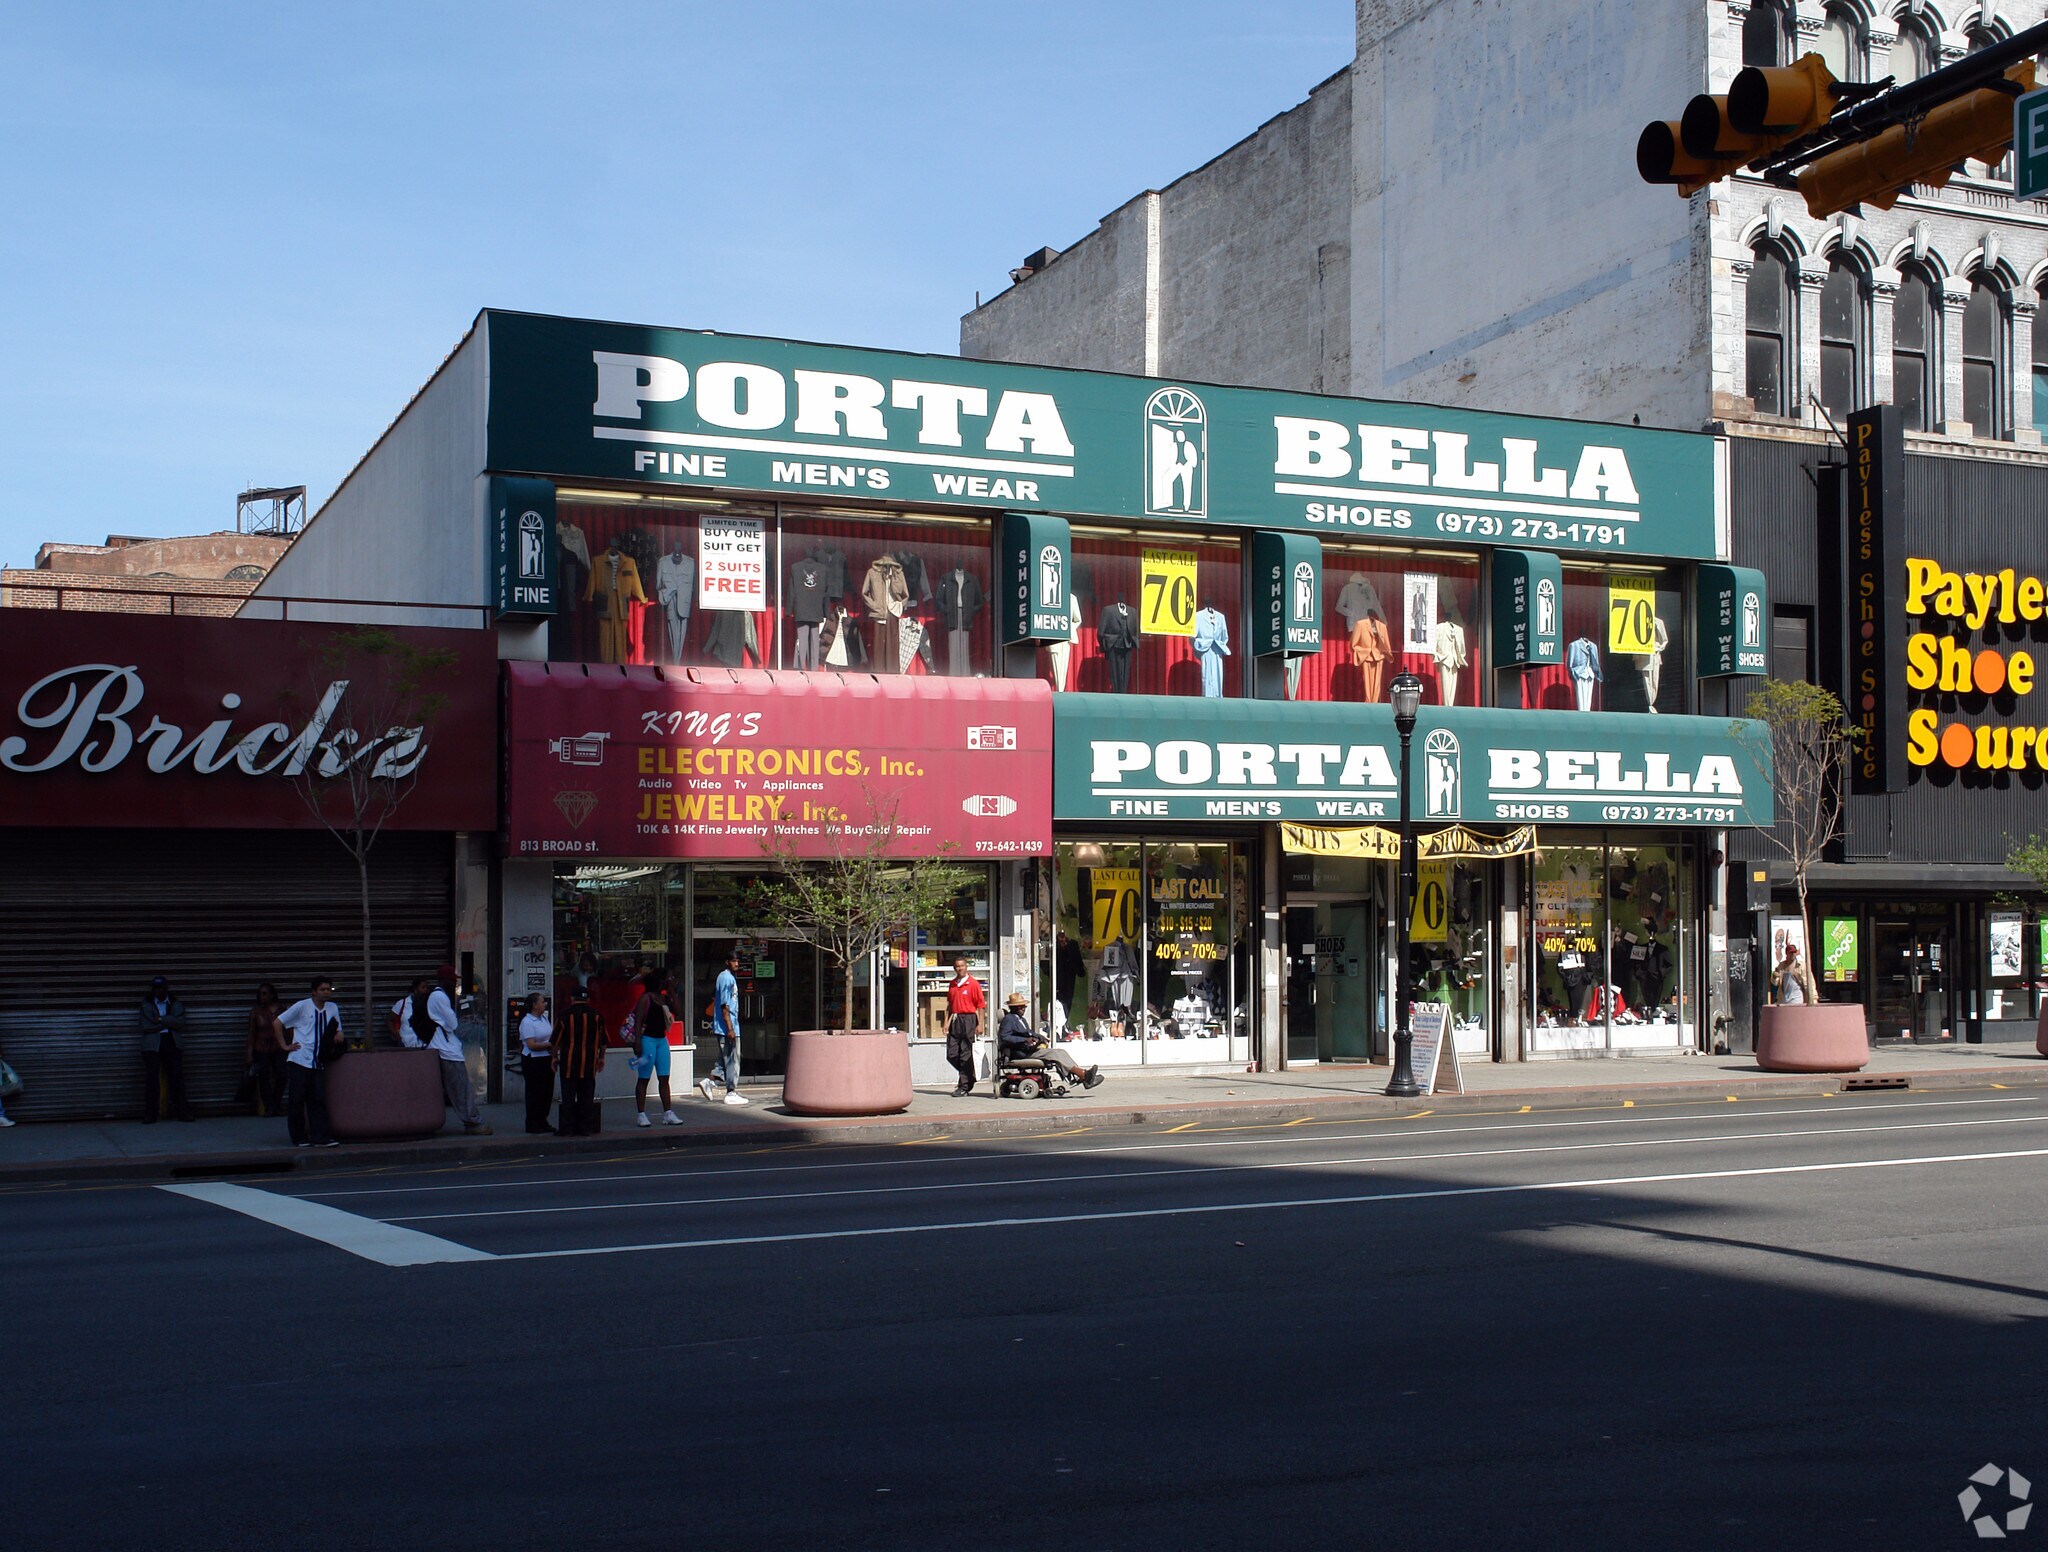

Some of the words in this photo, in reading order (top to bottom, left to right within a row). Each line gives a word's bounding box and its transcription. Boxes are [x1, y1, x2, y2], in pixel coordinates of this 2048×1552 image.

[593, 351, 1075, 458] PORTA
[1273, 416, 1640, 505] BELLA
[635, 450, 727, 478] FINE
[772, 460, 891, 490] MEN'S
[932, 474, 1040, 502] WEAR
[1305, 502, 1413, 529] SHOES
[1435, 512, 1504, 536] (973)
[1510, 518, 1626, 546] 273-1791
[1857, 423, 1873, 560] Payless
[707, 519, 738, 527] LIMITED
[739, 520, 757, 528] TIME
[704, 528, 731, 537] BUY
[735, 529, 760, 539] ONE
[703, 541, 733, 551] SUIT
[736, 543, 762, 553] GET
[705, 561, 713, 571] 2
[718, 561, 761, 573] SUITS
[1143, 550, 1168, 564] LAST
[1170, 552, 1196, 567] CALL
[704, 577, 761, 594] FREE
[1018, 549, 1027, 635] SHOES
[1905, 557, 2048, 630] Payle
[514, 586, 550, 604] FINE
[1144, 573, 1195, 626] 70%
[1270, 565, 1281, 648] SHOES
[1033, 613, 1069, 631] MEN'S
[1287, 627, 1320, 644] WEAR
[1513, 622, 1526, 661] WEAR
[1538, 641, 1555, 656] 807
[1718, 635, 1732, 671] WEAR
[1738, 652, 1765, 667] SHOES
[1906, 632, 2034, 695] Shoe
[638, 747, 871, 776] ELECTRONICS,
[880, 755, 924, 777] Inc.
[1090, 740, 1398, 786] PORTA
[1487, 748, 1743, 795] BELLA
[638, 778, 673, 789] Audio
[688, 778, 722, 789] Video
[734, 780, 747, 789] Tv
[762, 779, 824, 792] Appliances
[1110, 800, 1169, 816] FINE
[1205, 800, 1282, 816] MEN'S
[1315, 801, 1386, 817] WEAR
[1495, 803, 1570, 819] SHOES
[1601, 805, 1649, 820] (973)
[1653, 806, 1735, 822] 273-1791
[636, 824, 659, 834] 10K
[661, 825, 670, 834] &
[674, 824, 696, 834] 14K
[698, 824, 723, 834] Fine
[724, 824, 768, 836] Jewelry
[774, 825, 819, 835] Watches
[896, 825, 932, 837] Repair
[520, 840, 539, 851] 813
[542, 840, 582, 851] BROAD
[975, 840, 1043, 852] 973-642-1439
[1093, 870, 1116, 881] LAST
[1151, 878, 1187, 899] LAST
[1189, 879, 1224, 899] CALL
[1161, 915, 1174, 932] $10
[1180, 915, 1193, 932] $15
[1199, 915, 1212, 932] $20
[1155, 943, 1181, 960] 40%
[1191, 943, 1217, 959] 70%
[1315, 937, 1346, 953] SHOES
[1544, 937, 1566, 953] 40%
[1574, 937, 1597, 953] 70%
[1826, 933, 1854, 966] bogo
